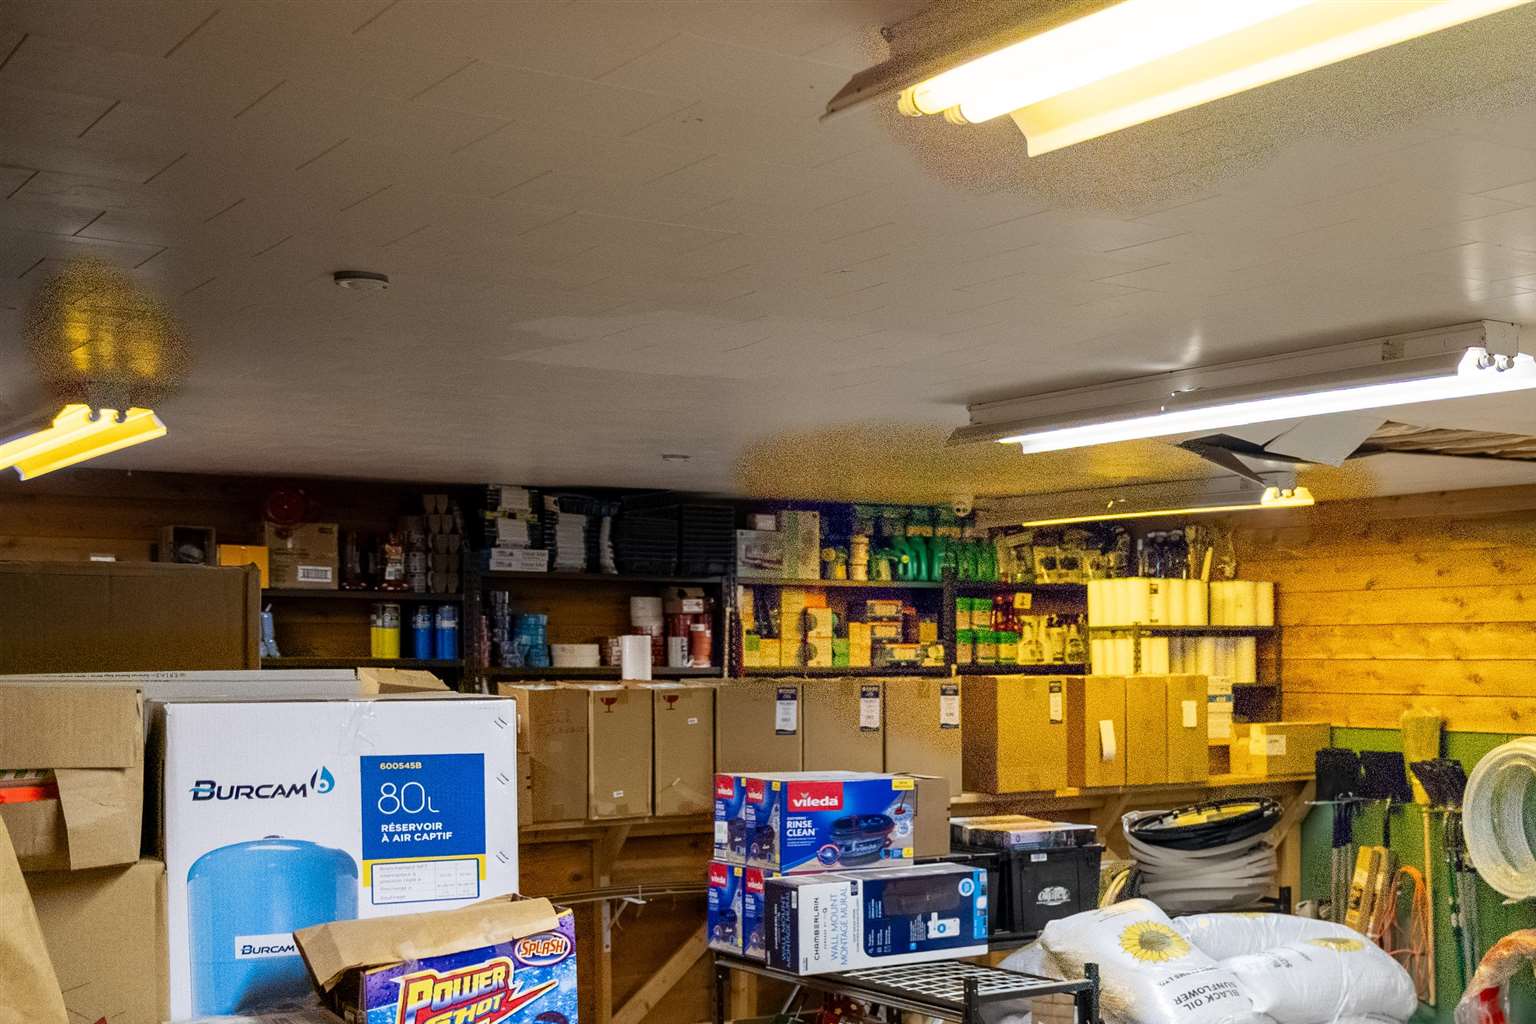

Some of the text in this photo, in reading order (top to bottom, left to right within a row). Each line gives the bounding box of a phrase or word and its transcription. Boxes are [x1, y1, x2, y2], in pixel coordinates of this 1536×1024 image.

[189, 780, 307, 801] BURCAM
[793, 793, 838, 808] vileda
[381, 822, 443, 833] RÉSERVOIR
[786, 820, 813, 829] RINSE
[381, 832, 453, 843] À AIR CAPTIF
[786, 828, 816, 837] CLEAN
[840, 887, 848, 966] MONTAGE MURAL
[241, 945, 295, 955] BURCAM
[521, 938, 565, 957] SPLASH
[1183, 998, 1203, 1011] OIL
